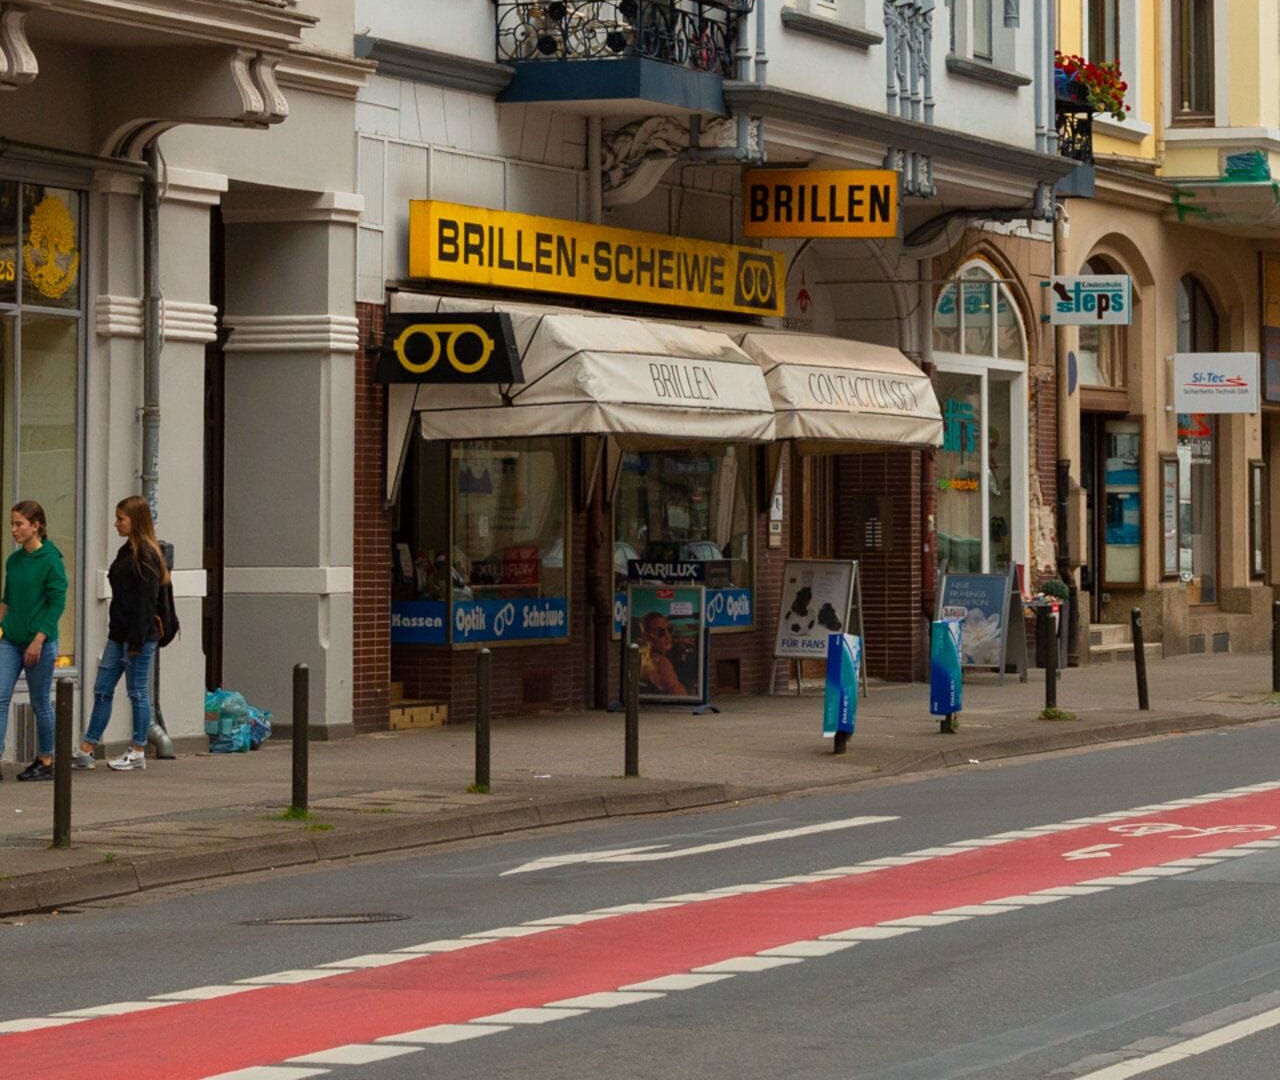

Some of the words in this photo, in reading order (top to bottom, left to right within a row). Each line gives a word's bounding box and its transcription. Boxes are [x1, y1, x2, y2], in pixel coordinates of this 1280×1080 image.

[750, 184, 891, 223] BRILLEN
[438, 218, 725, 296] BRILLEN-SCHEIWE
[1056, 281, 1124, 320] steps
[649, 363, 720, 401] BRILLEN
[1192, 373, 1225, 383] Si-Tec
[635, 563, 696, 577] VARILUX
[392, 614, 442, 627] Kassen
[456, 605, 486, 636] Optik
[523, 603, 564, 628] Scheiwe
[727, 593, 750, 621] Optik
[802, 639, 824, 648] FANS
